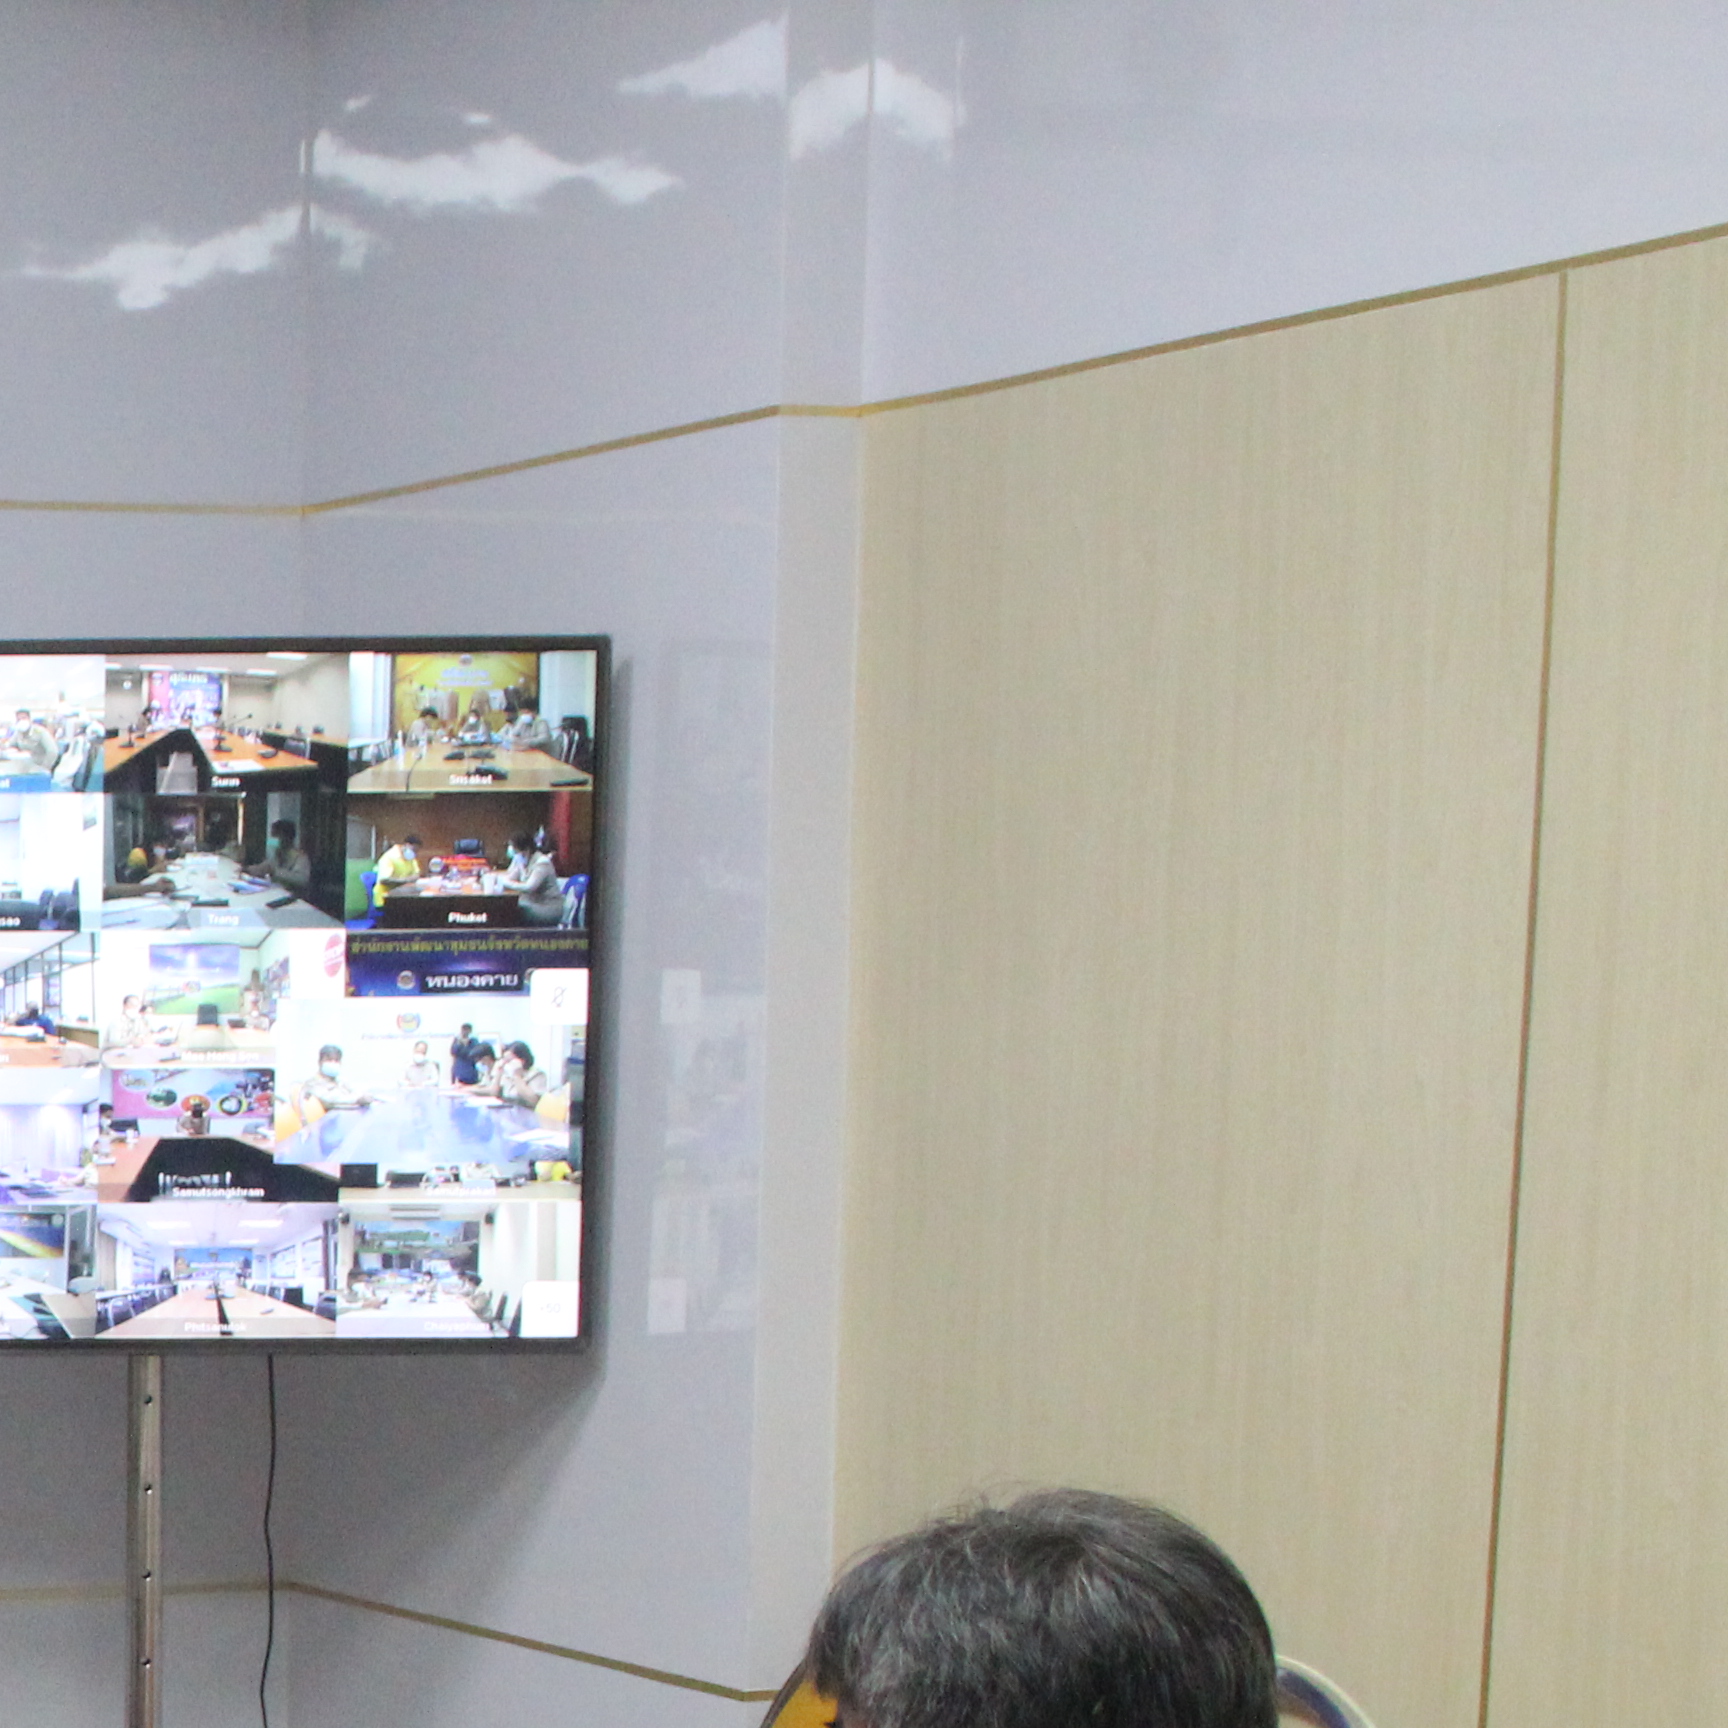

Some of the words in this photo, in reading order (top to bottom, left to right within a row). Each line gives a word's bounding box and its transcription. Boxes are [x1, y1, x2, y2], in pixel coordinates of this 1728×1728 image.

[211, 776, 241, 787] Surin
[208, 914, 240, 927] Trang
[447, 912, 488, 924] Phuket
[425, 973, 519, 989] หนองคาย
